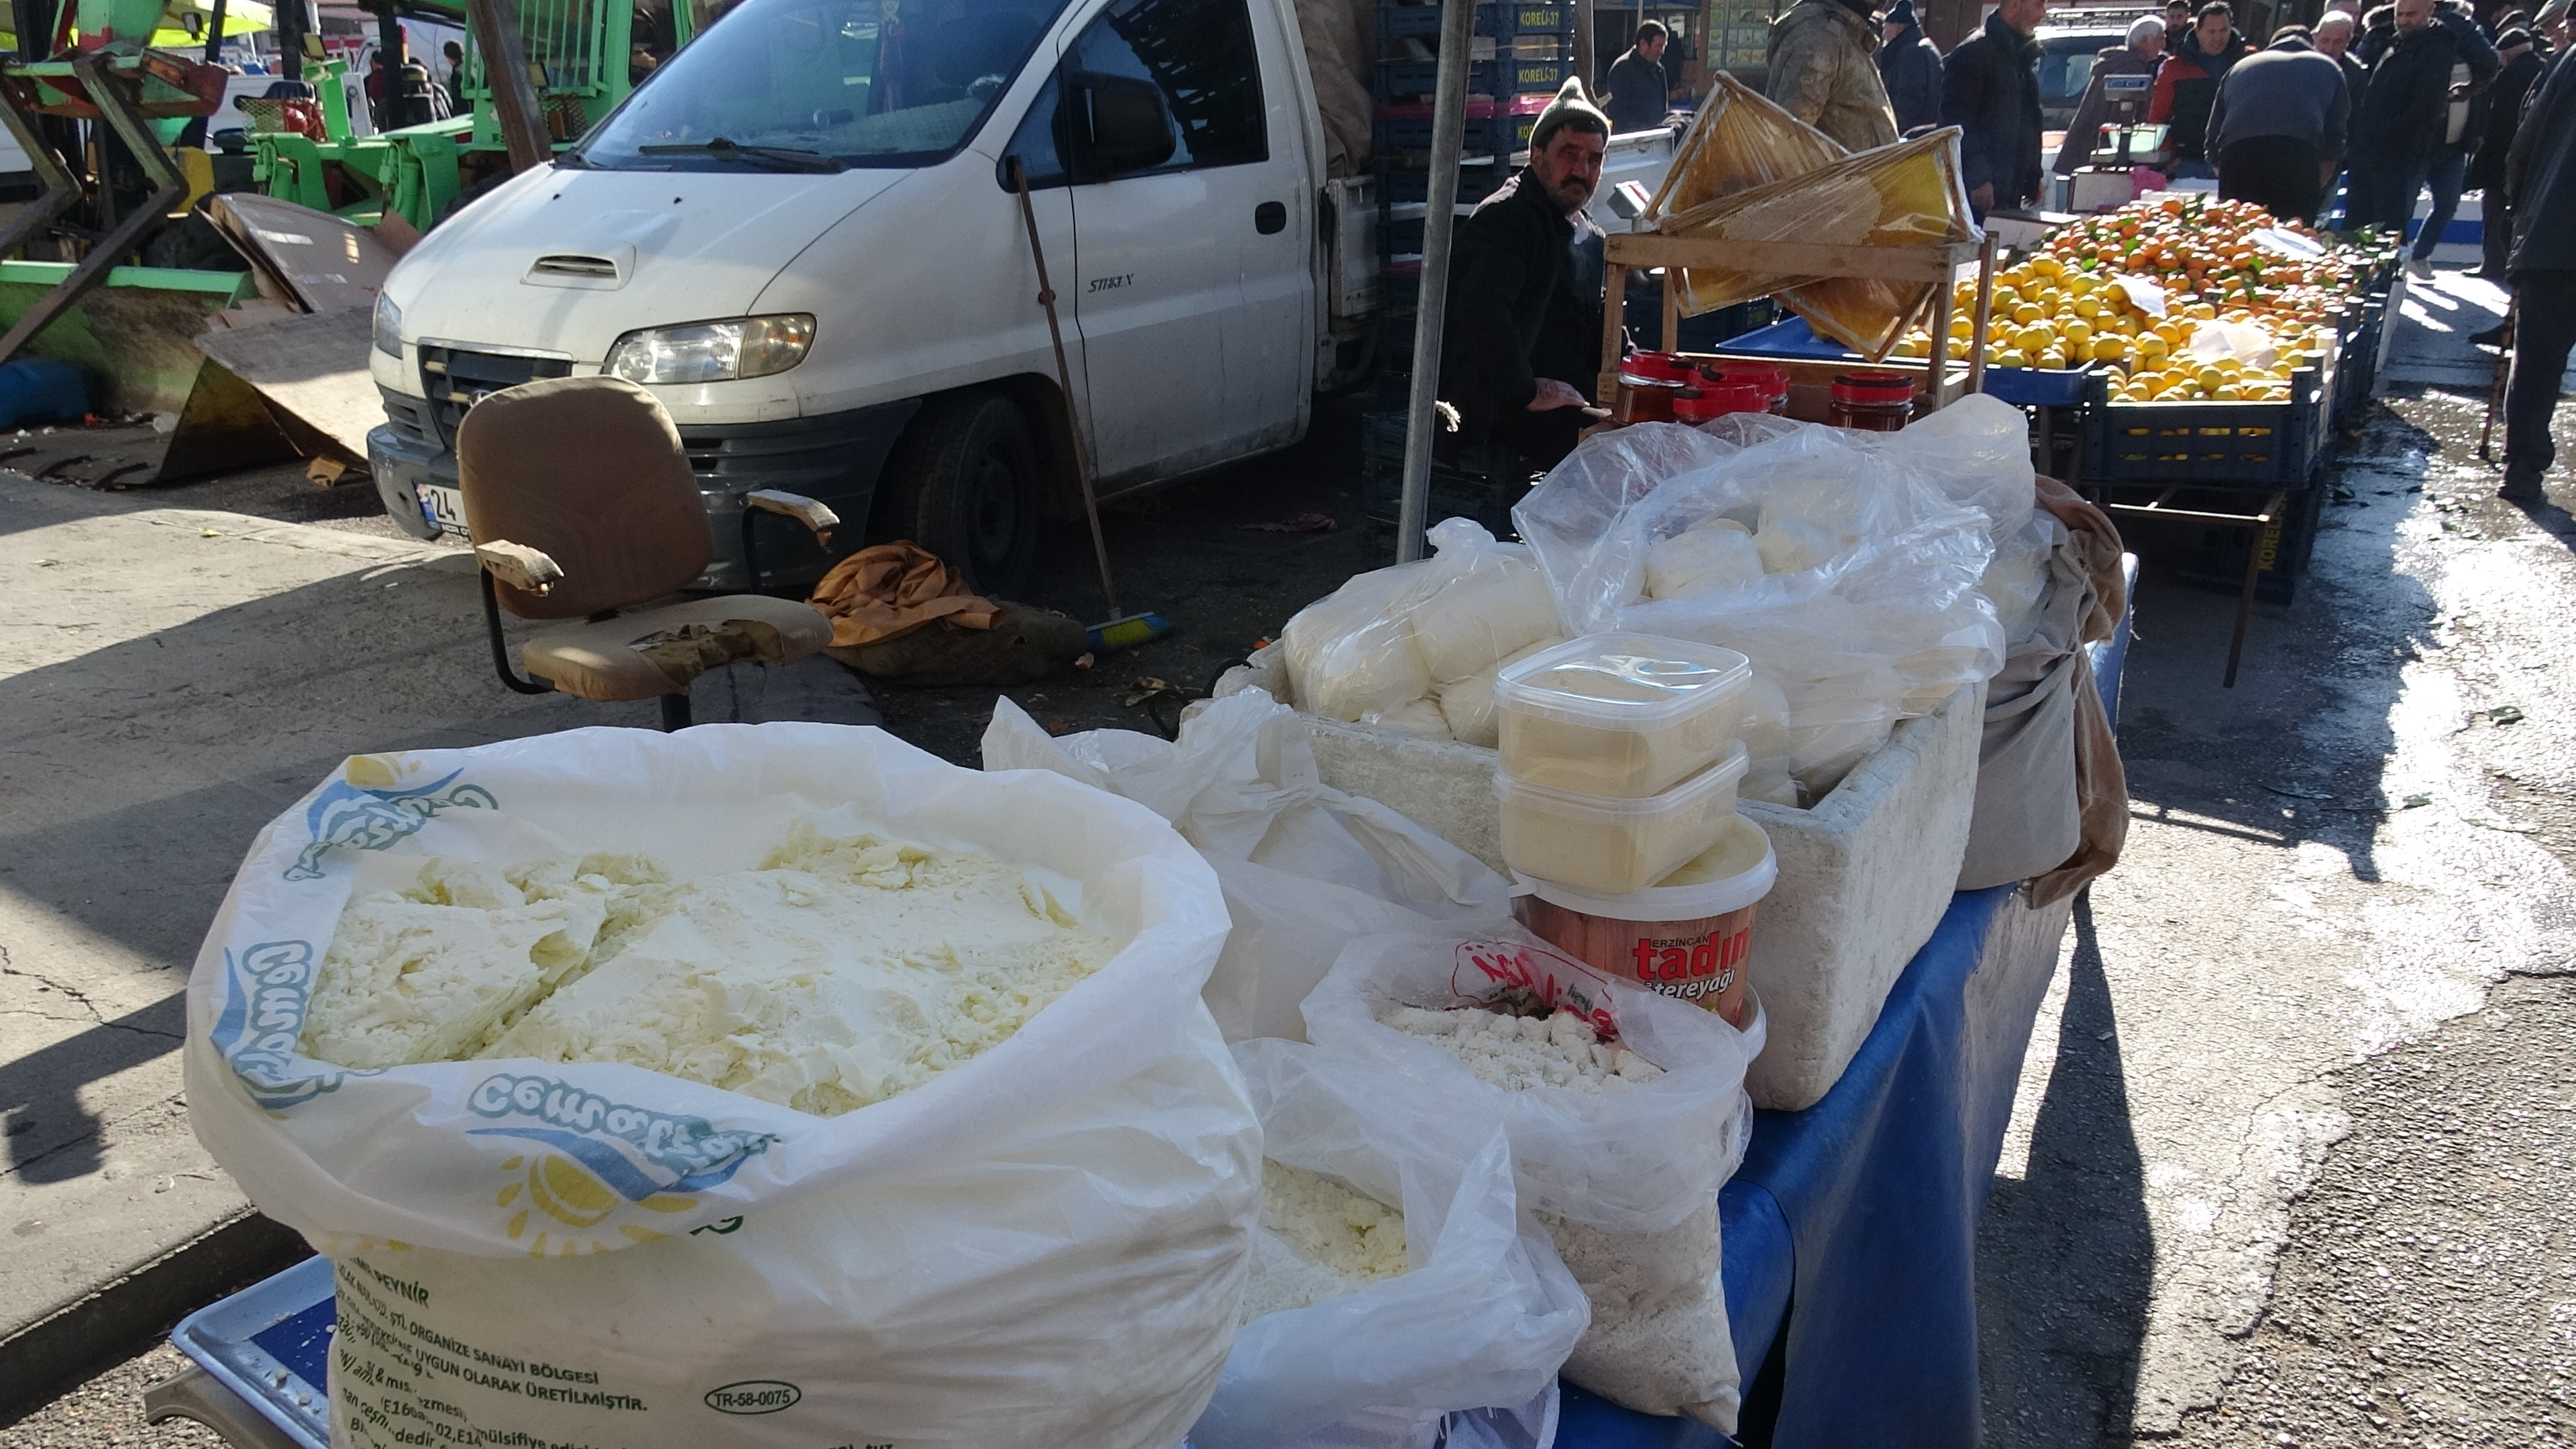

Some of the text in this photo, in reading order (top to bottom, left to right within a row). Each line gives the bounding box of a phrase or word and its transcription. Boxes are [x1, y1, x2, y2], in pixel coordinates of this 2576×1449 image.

[431, 488, 456, 521] 24
[1652, 934, 1710, 948] ERZİNCAN
[1655, 967, 1735, 1001] tereyağı
[410, 1321, 470, 1358] ORGANİZE
[474, 1348, 525, 1375] SANAYİ
[530, 1362, 599, 1386] BÖLGESİ
[415, 1348, 460, 1378] UYGUN
[463, 1366, 523, 1395] OLARAK
[526, 1382, 648, 1411] ÜRETİLMİŞTİR.
[714, 1389, 791, 1407] TR-58-0075
